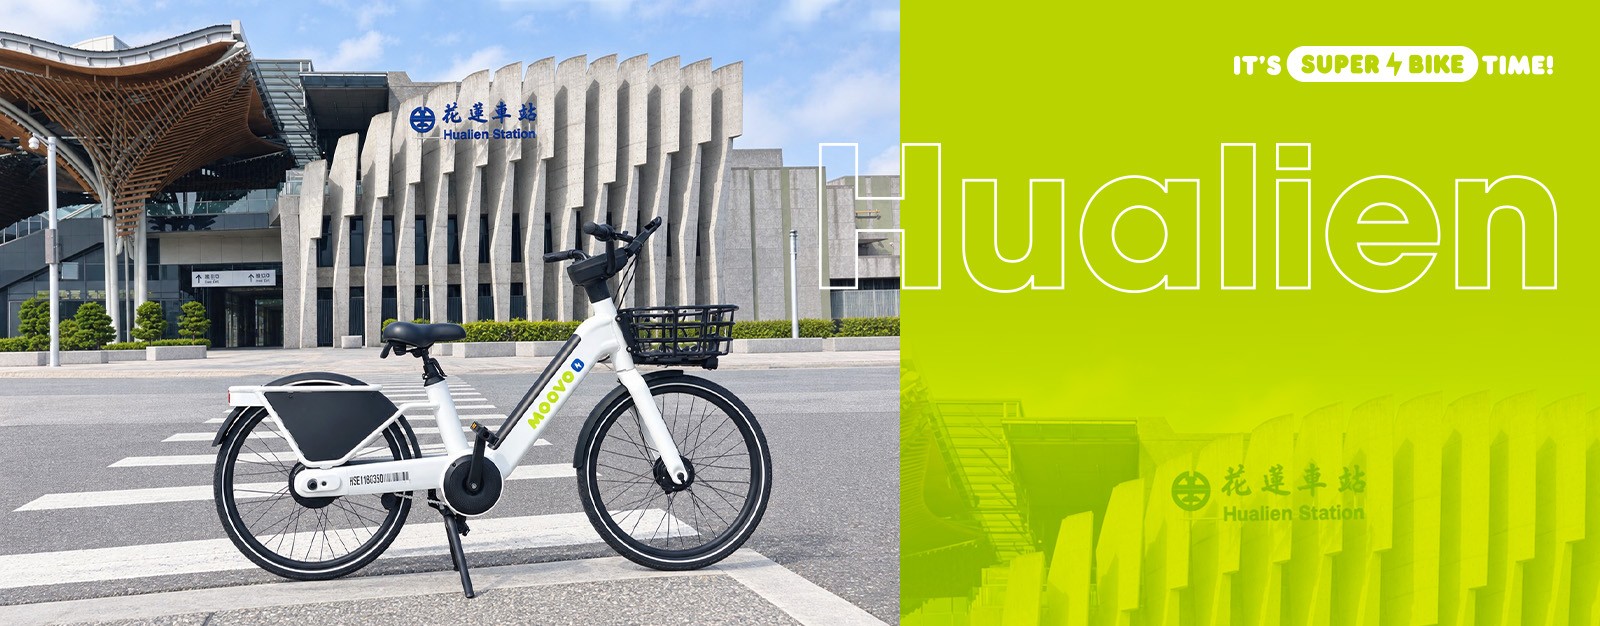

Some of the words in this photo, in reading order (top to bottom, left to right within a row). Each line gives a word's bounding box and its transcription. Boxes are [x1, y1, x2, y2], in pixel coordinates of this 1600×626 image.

[442, 101, 537, 124] 花蓮車站
[443, 129, 489, 140] Hualien
[493, 128, 536, 140] Station
[527, 370, 575, 430] MOOVO
[1221, 463, 1367, 497] 花蓮車站
[1223, 505, 1293, 522] Hualien
[1298, 504, 1365, 521] Station
